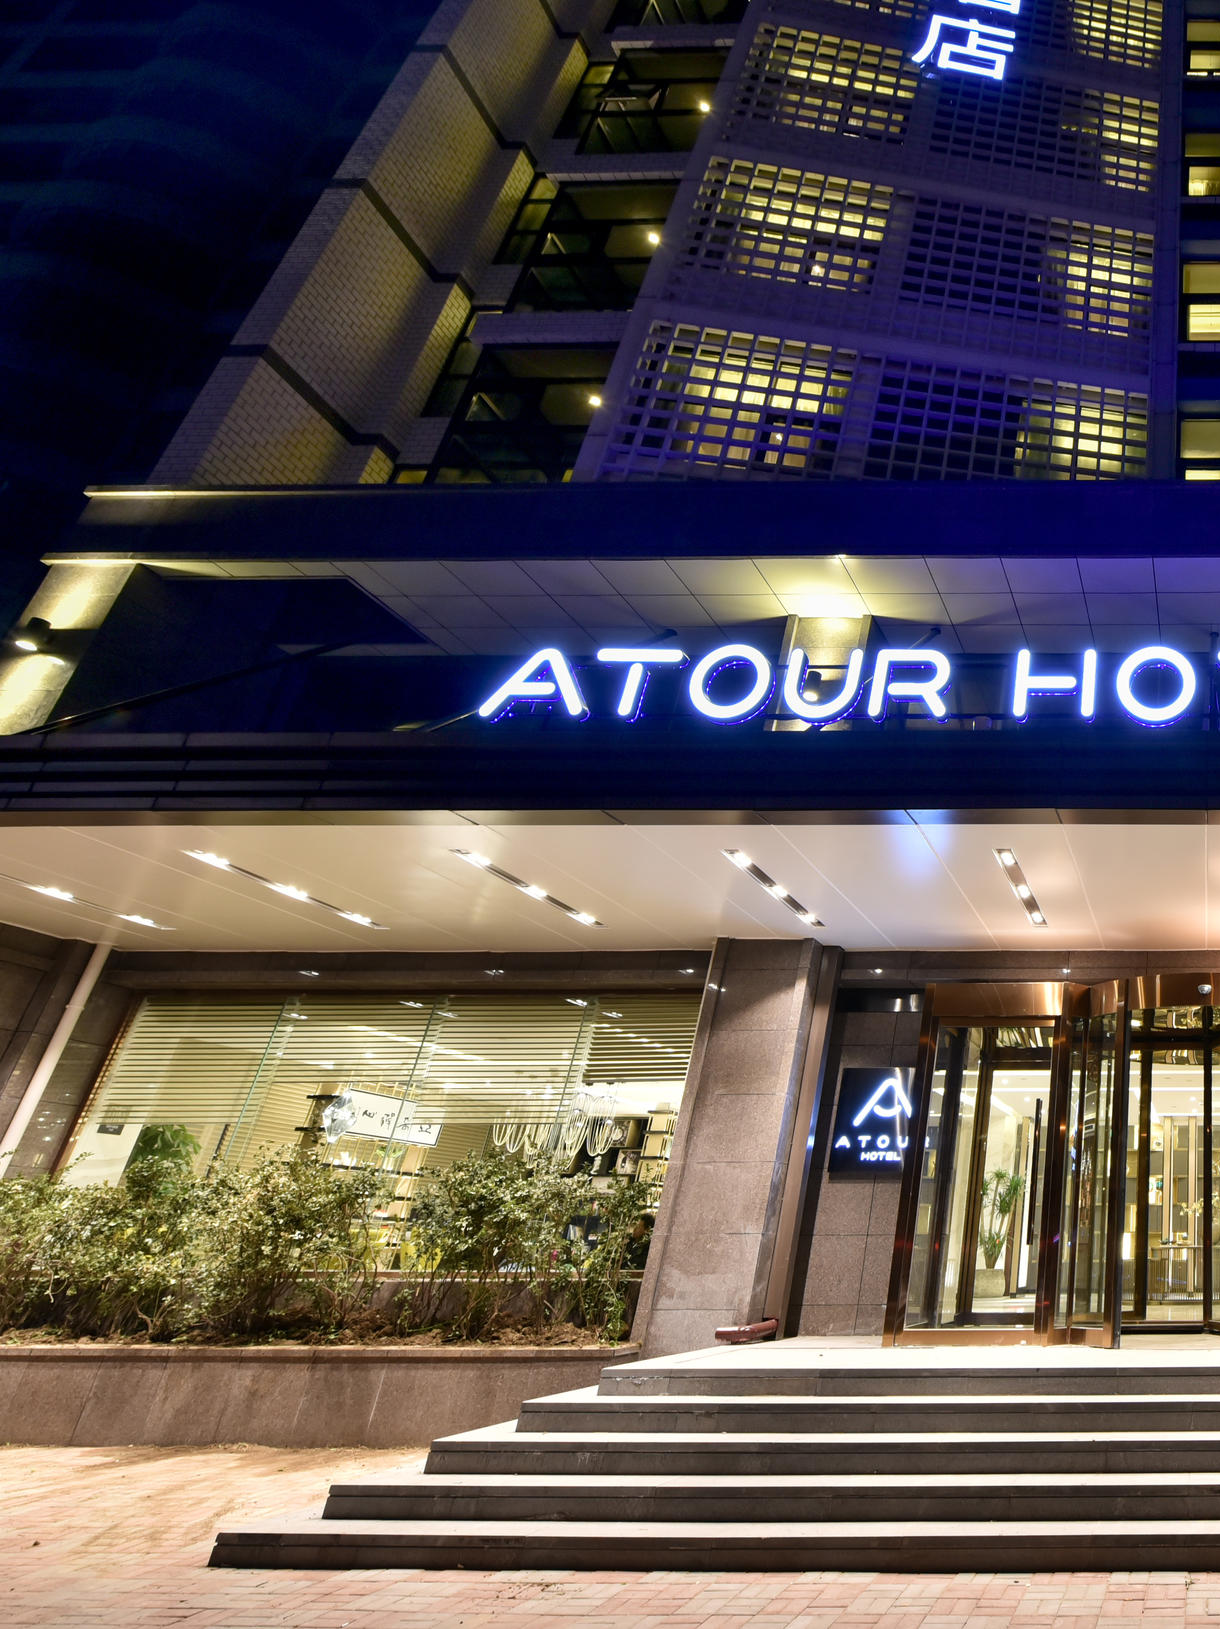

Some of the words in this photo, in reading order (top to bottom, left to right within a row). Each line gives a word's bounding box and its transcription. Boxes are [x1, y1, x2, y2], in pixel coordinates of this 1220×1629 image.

[911, 0, 1021, 80] 店
[478, 643, 950, 720] ATOUR
[860, 1151, 901, 1161] HOTEL
